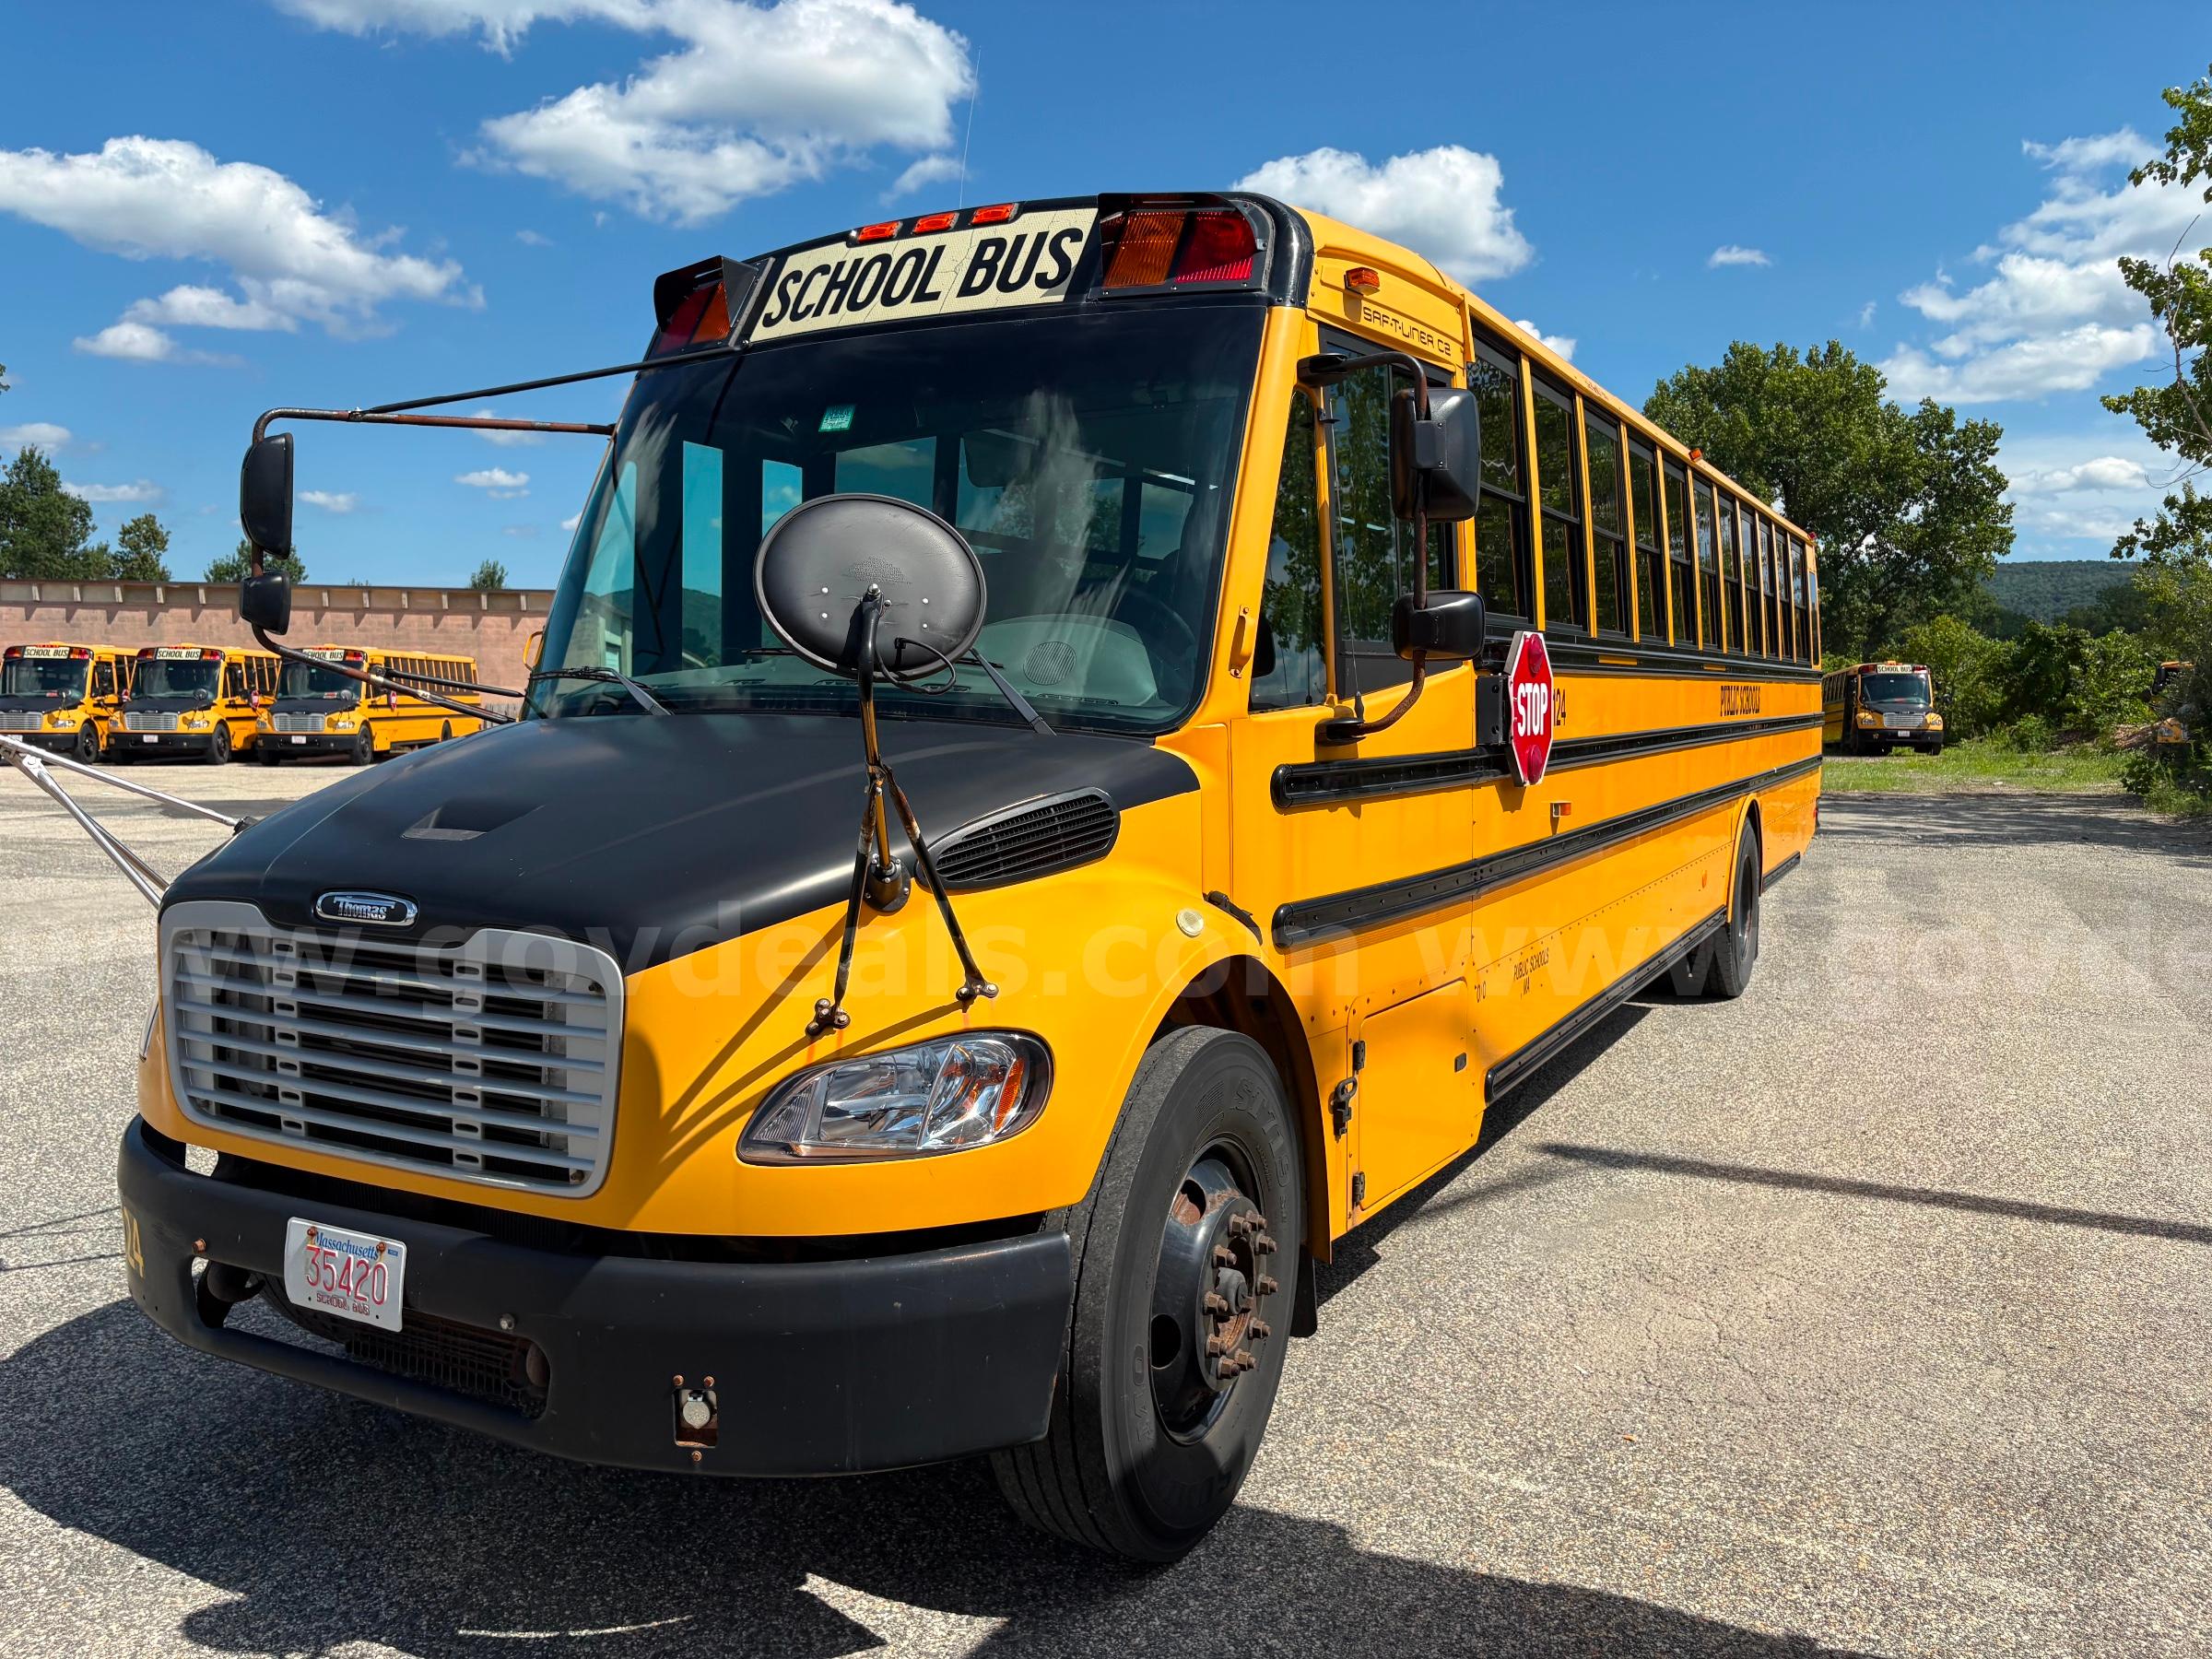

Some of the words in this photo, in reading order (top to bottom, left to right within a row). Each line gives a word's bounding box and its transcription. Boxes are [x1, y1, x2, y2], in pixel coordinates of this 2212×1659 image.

[762, 244, 947, 329] SCHOOL
[956, 227, 1084, 299] BUS
[1437, 338, 1452, 357] C2
[25, 648, 51, 657] SCHOOL
[53, 649, 69, 658] BUS
[157, 649, 183, 658] SCHOOL
[185, 650, 200, 659] BUS
[329, 651, 343, 660] BUS
[1516, 682, 1548, 737] STOP
[1720, 685, 1739, 717] PUBLIC
[1739, 685, 1761, 715] SCHOOLS
[333, 896, 396, 921] Thomas
[1513, 958, 1529, 982] PUBLIC
[1529, 947, 1549, 973] SCHOOLS
[314, 1231, 380, 1261] Massachusetts
[305, 1243, 389, 1306] 35420
